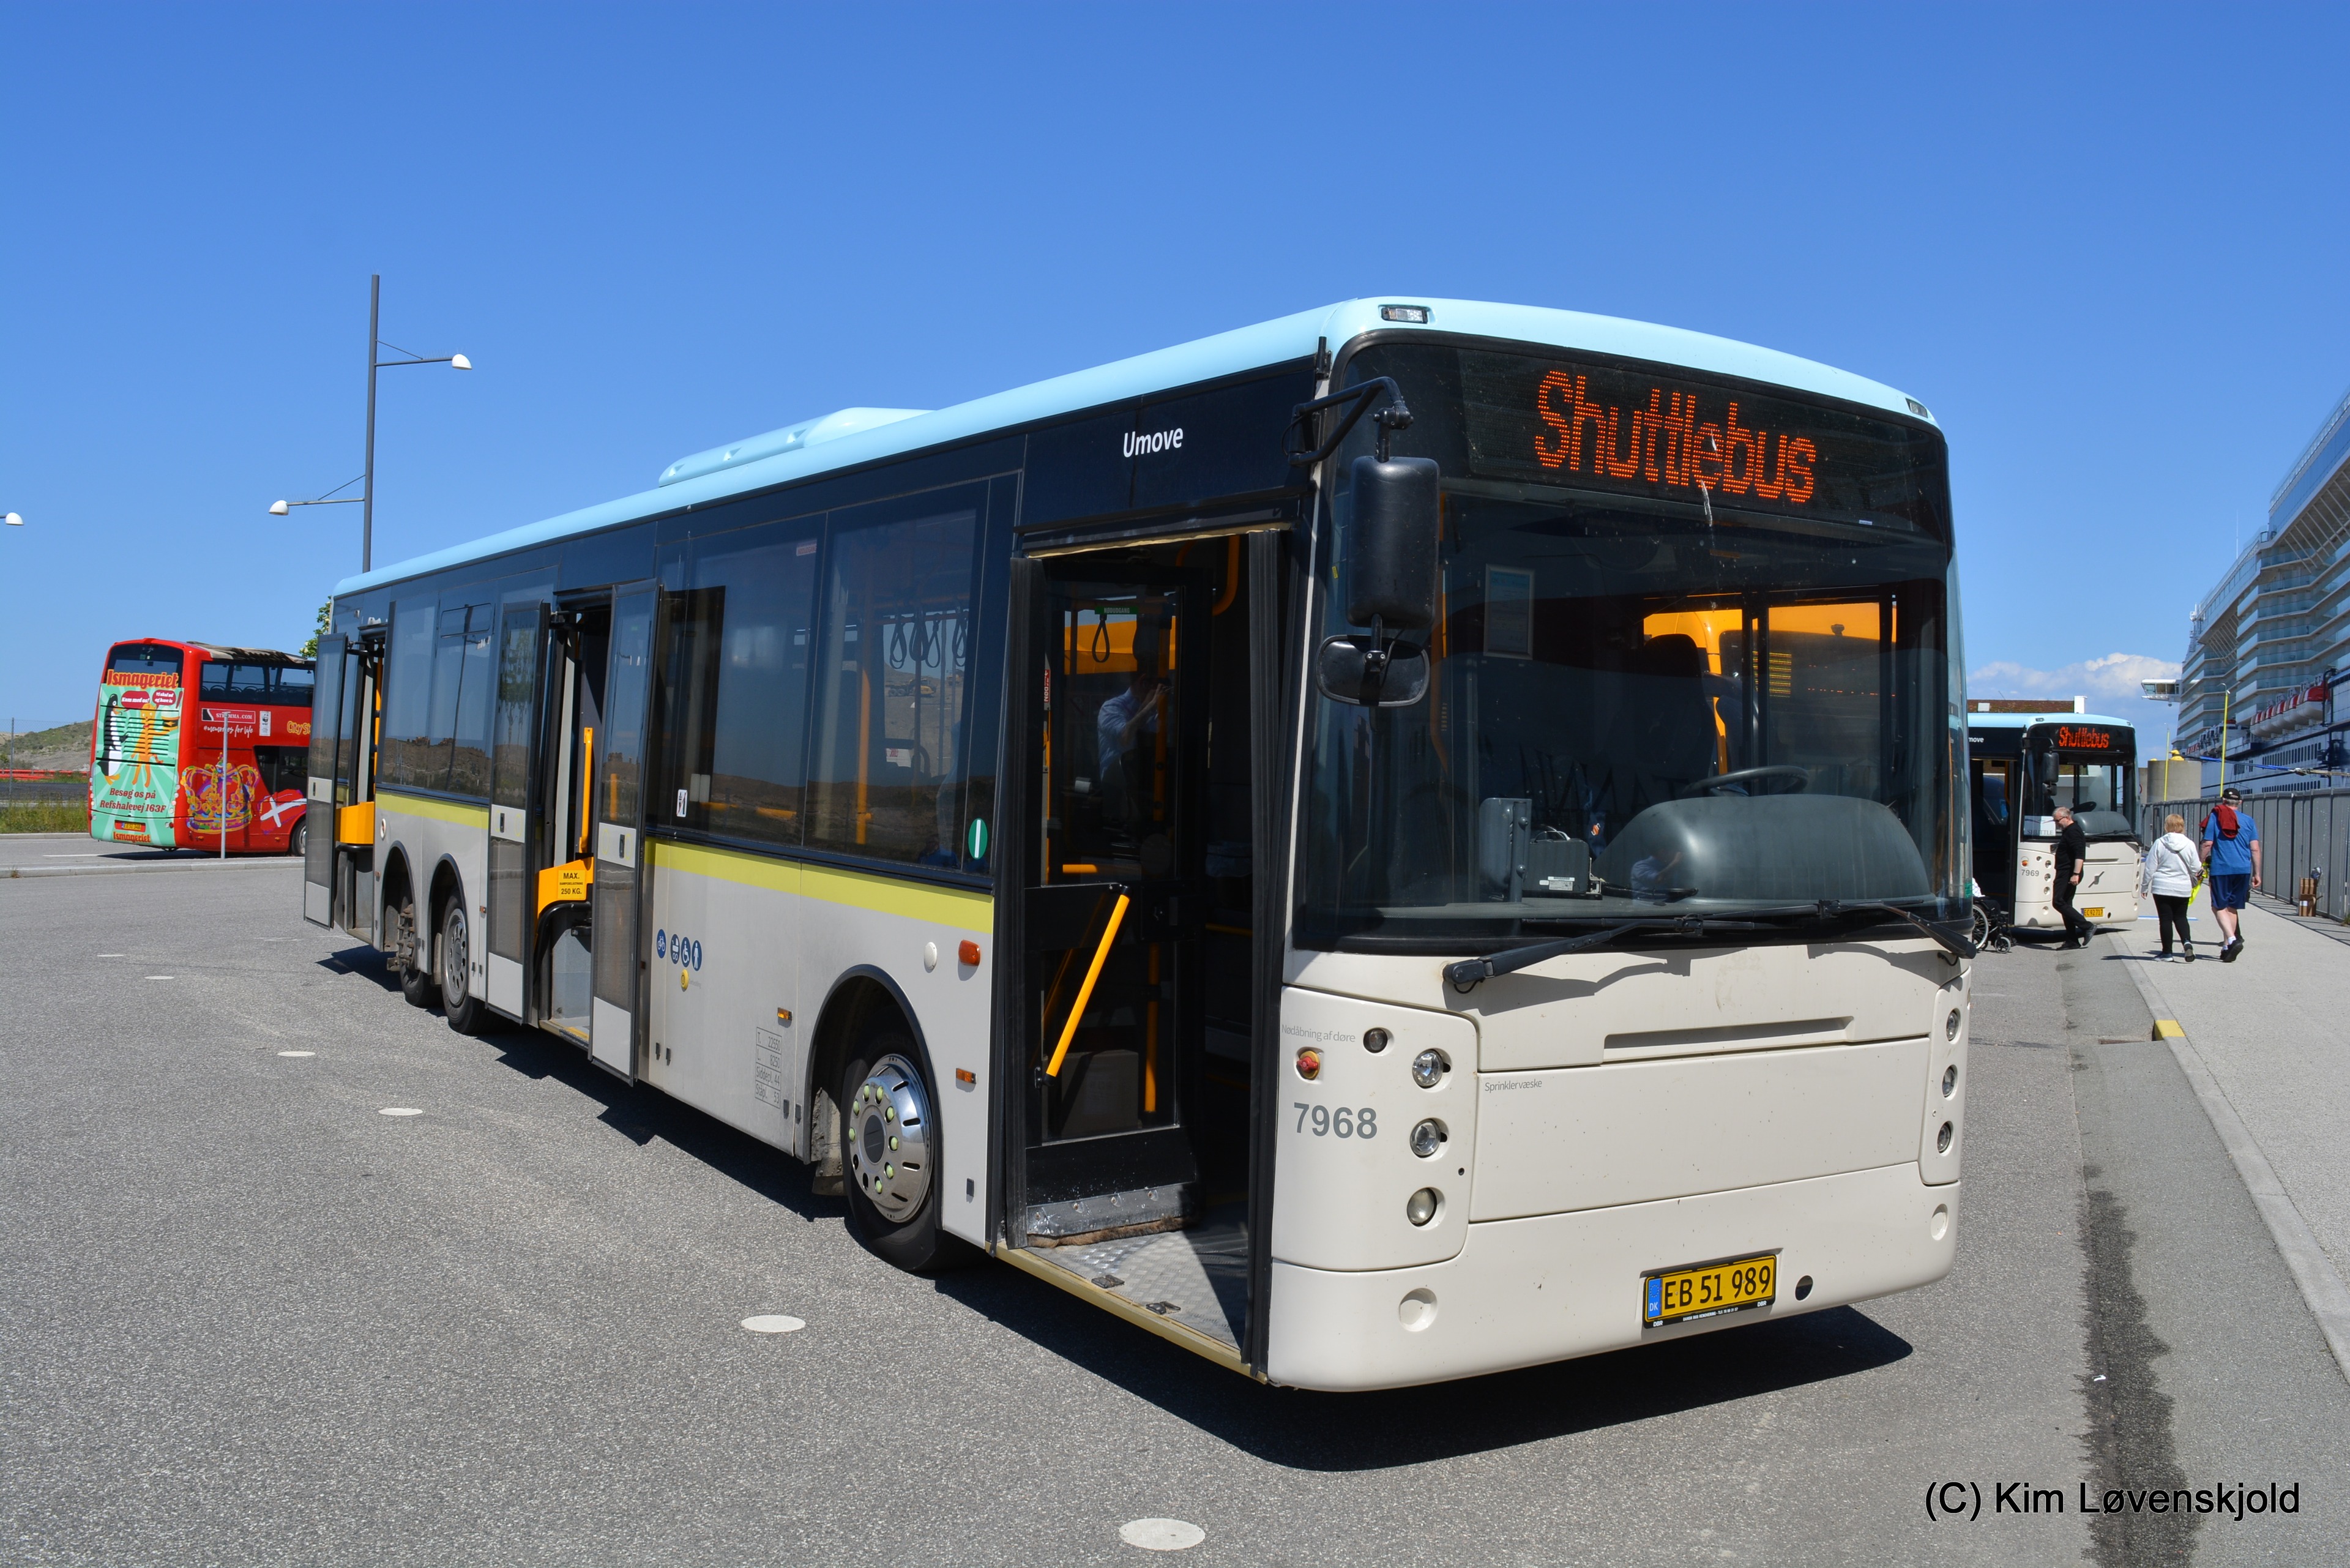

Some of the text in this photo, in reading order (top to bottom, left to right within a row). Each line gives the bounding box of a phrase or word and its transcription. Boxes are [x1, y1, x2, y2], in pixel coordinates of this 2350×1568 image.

[1124, 428, 1183, 458] Umove
[1535, 370, 1816, 503] Shuttlebus
[106, 670, 179, 690] Ismageriet
[244, 725, 253, 738] life
[2058, 726, 2109, 749] Shuttlebus
[109, 788, 133, 799] Besøg
[144, 790, 155, 800] på
[100, 800, 166, 813] Refshalevej 163F
[113, 831, 151, 843] Ismageriet
[1281, 1024, 1356, 1042] Nødåbning af døre
[770, 1055, 780, 1069] 8250
[774, 1075, 780, 1087] 44
[1485, 1078, 1542, 1093] Sprinklervæske
[774, 1091, 780, 1104] 53
[1294, 1102, 1378, 1139] 7968
[1664, 1265, 1770, 1310] EB 51 989
[1649, 1302, 1658, 1312] DK
